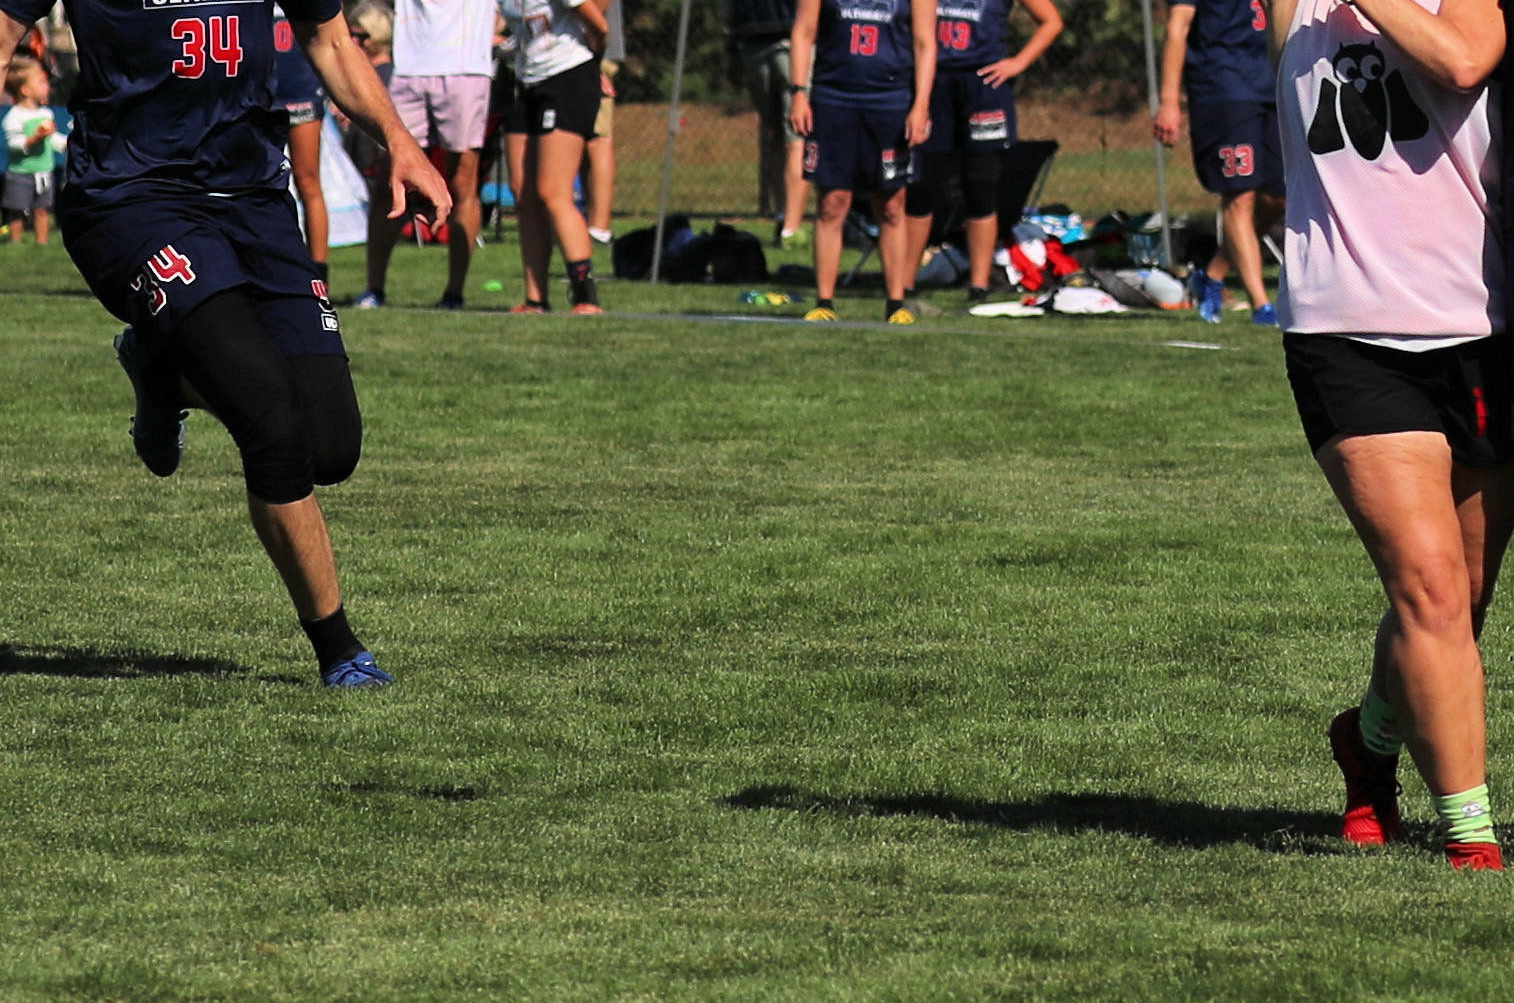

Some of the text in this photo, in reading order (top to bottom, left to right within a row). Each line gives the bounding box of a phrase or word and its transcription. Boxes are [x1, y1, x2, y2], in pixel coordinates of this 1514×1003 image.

[1250, 0, 1267, 31] 3
[171, 15, 244, 79] 34
[849, 23, 880, 57] 13
[937, 21, 972, 51] 43
[1219, 144, 1255, 177] 33
[130, 244, 196, 316] 34
